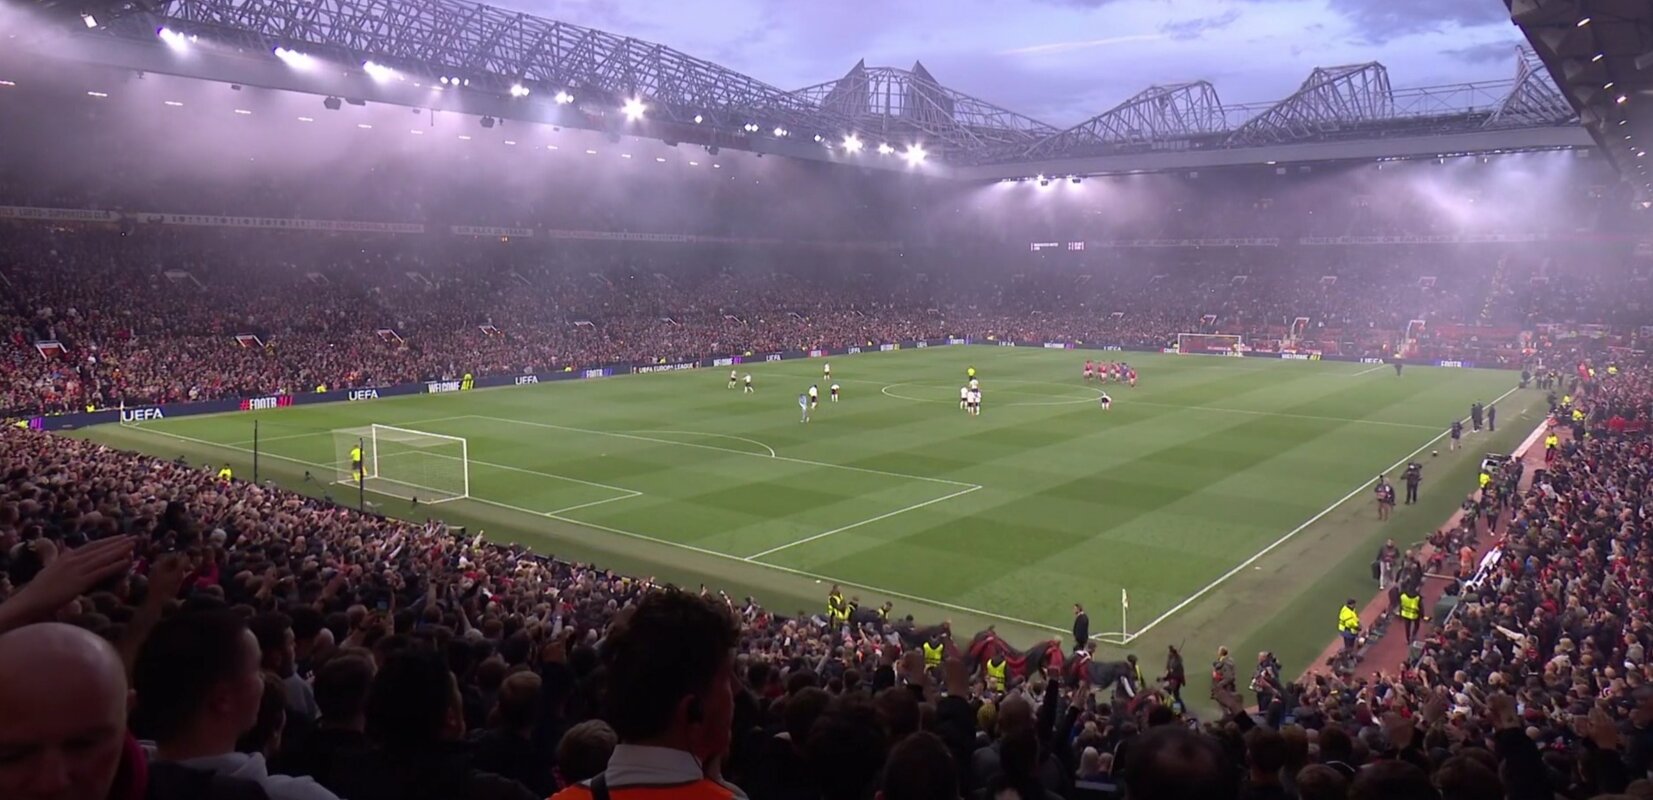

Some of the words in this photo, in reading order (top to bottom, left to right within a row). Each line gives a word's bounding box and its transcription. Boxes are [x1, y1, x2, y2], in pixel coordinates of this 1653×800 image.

[515, 375, 539, 385] UEFA
[428, 381, 460, 394] WELCOME
[349, 389, 379, 401] UEFA
[122, 408, 163, 422] UEFA
